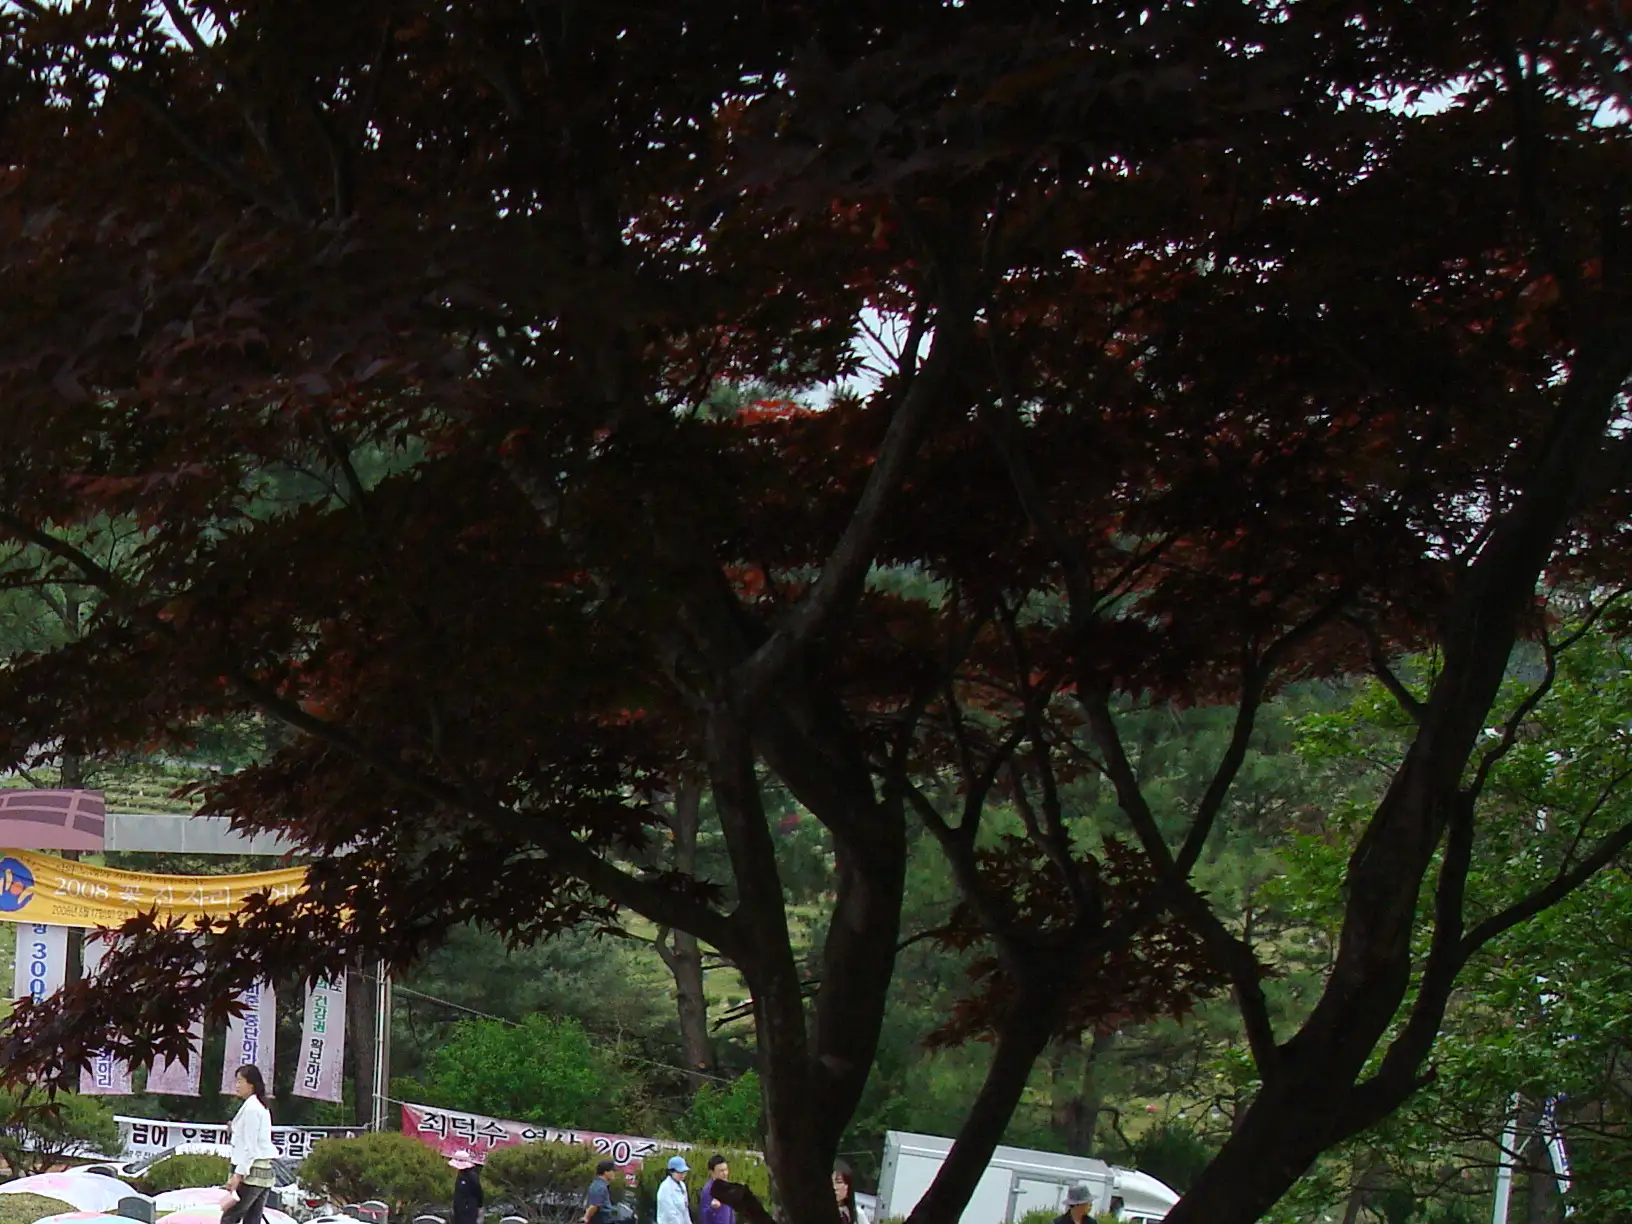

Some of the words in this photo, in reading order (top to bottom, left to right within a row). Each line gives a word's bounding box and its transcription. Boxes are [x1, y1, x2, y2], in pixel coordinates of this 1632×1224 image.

[53, 876, 109, 901] 2008
[183, 885, 231, 909] 자리
[313, 994, 328, 1034] 건강권
[304, 1037, 324, 1090] 확보하라
